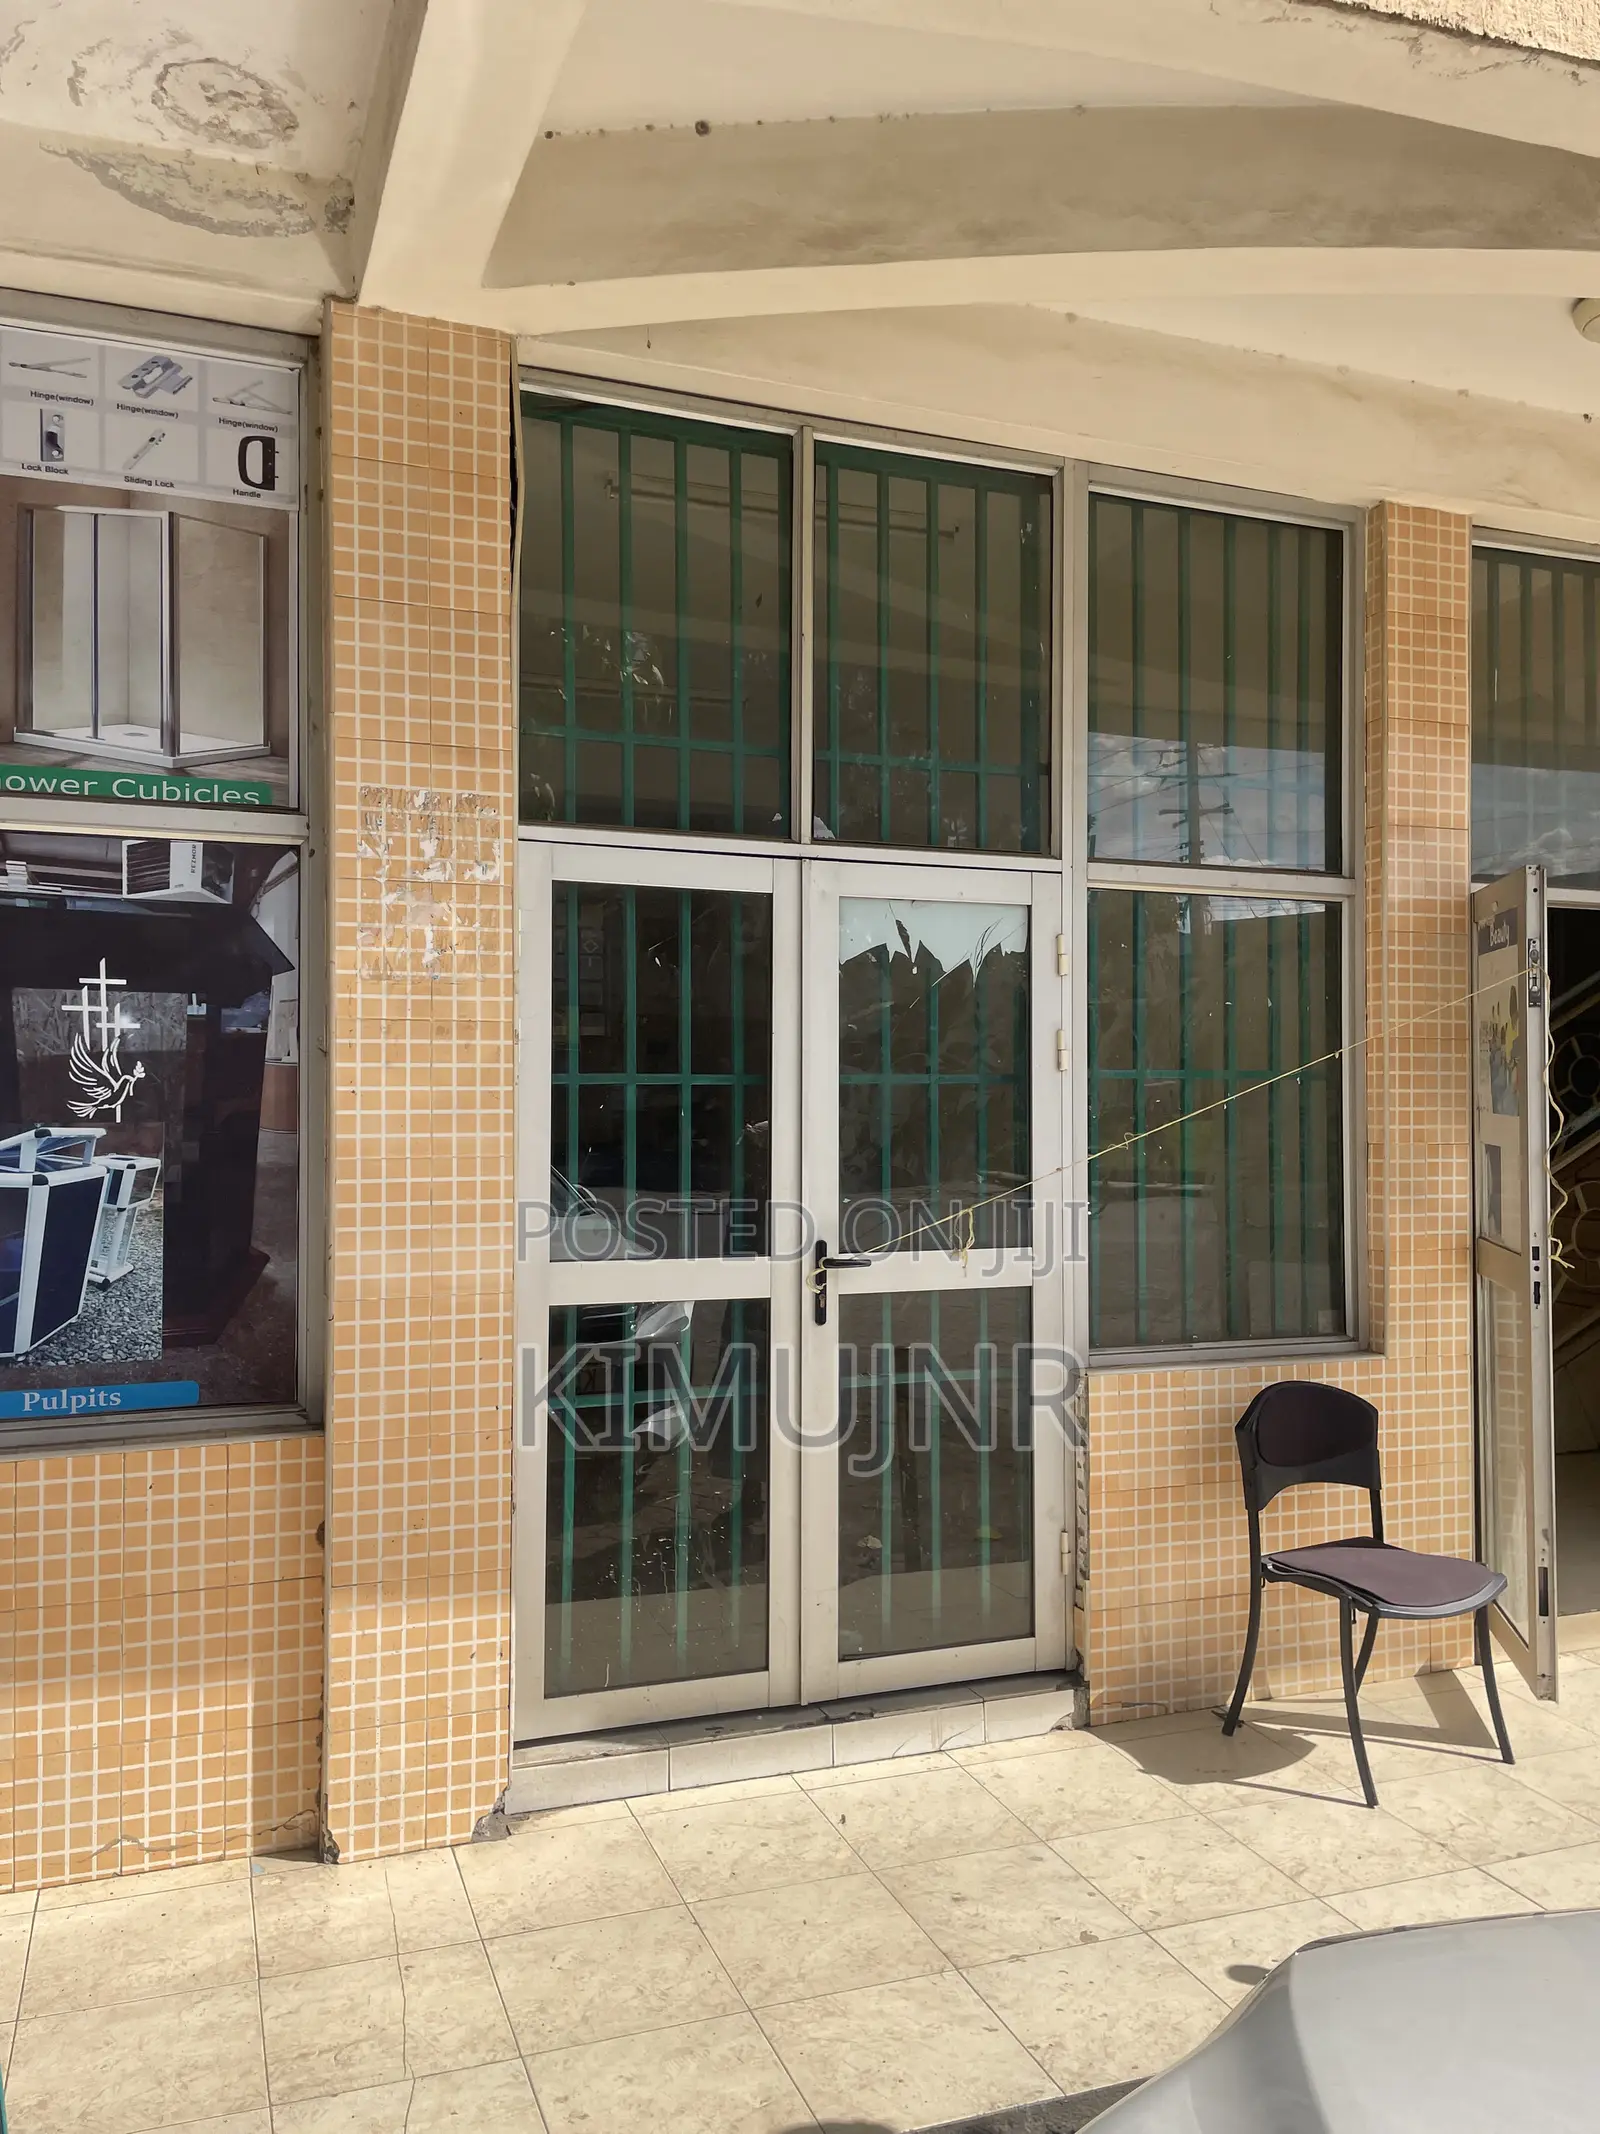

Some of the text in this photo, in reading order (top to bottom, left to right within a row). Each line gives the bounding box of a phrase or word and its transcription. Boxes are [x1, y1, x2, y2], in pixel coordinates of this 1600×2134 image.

[30, 390, 94, 406] Hinge(window)
[116, 402, 179, 419] Hinge(window)
[218, 417, 279, 433] Hinge(window)
[21, 462, 69, 475] Lock Block
[124, 475, 175, 489] Sliding Lock
[232, 488, 261, 499] Handle
[0, 774, 260, 805] ower Cubicles
[22, 1387, 122, 1413] Pulpits
